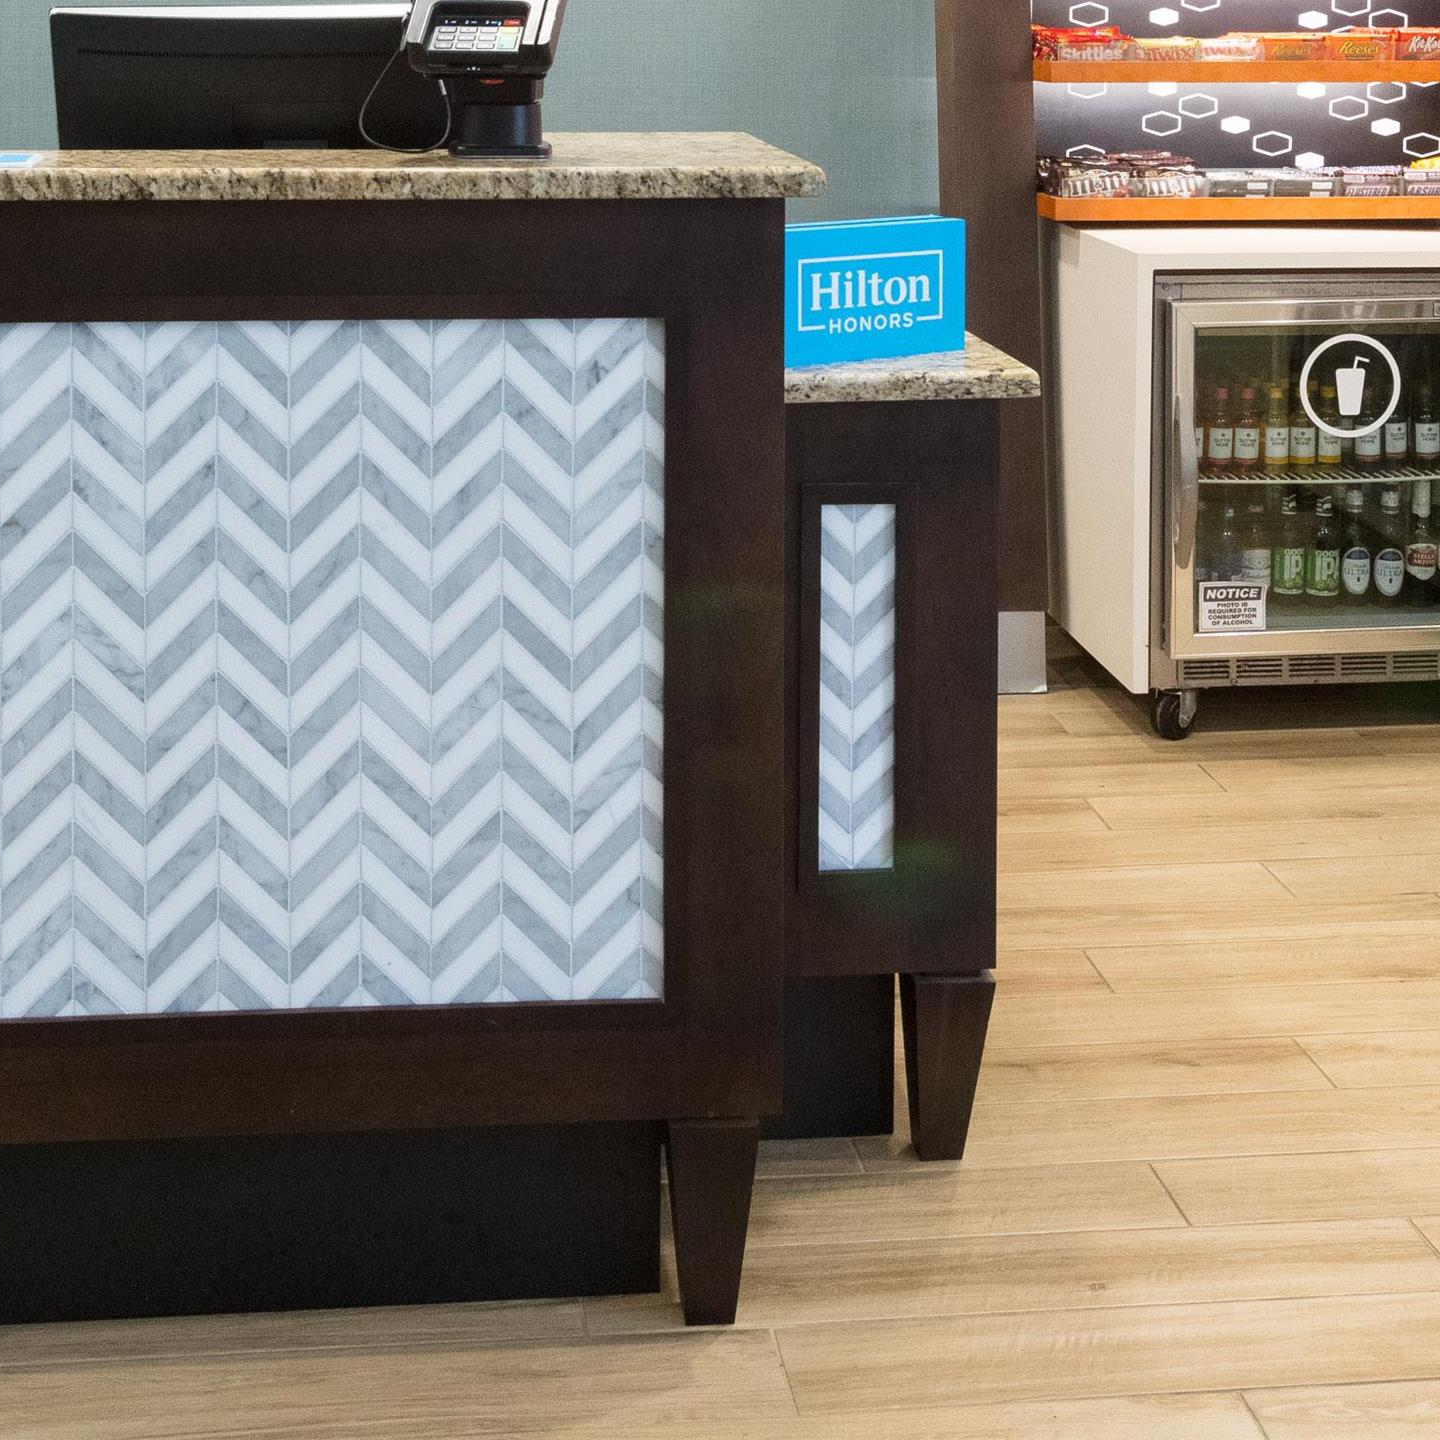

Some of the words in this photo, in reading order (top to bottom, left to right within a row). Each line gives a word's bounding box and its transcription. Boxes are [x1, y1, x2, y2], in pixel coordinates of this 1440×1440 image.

[1061, 46, 1123, 61] Skittles
[810, 269, 932, 311] Hilton
[828, 312, 915, 335] HONORS
[1206, 587, 1260, 600] NOTICE
[1207, 607, 1243, 615] REQUIRED
